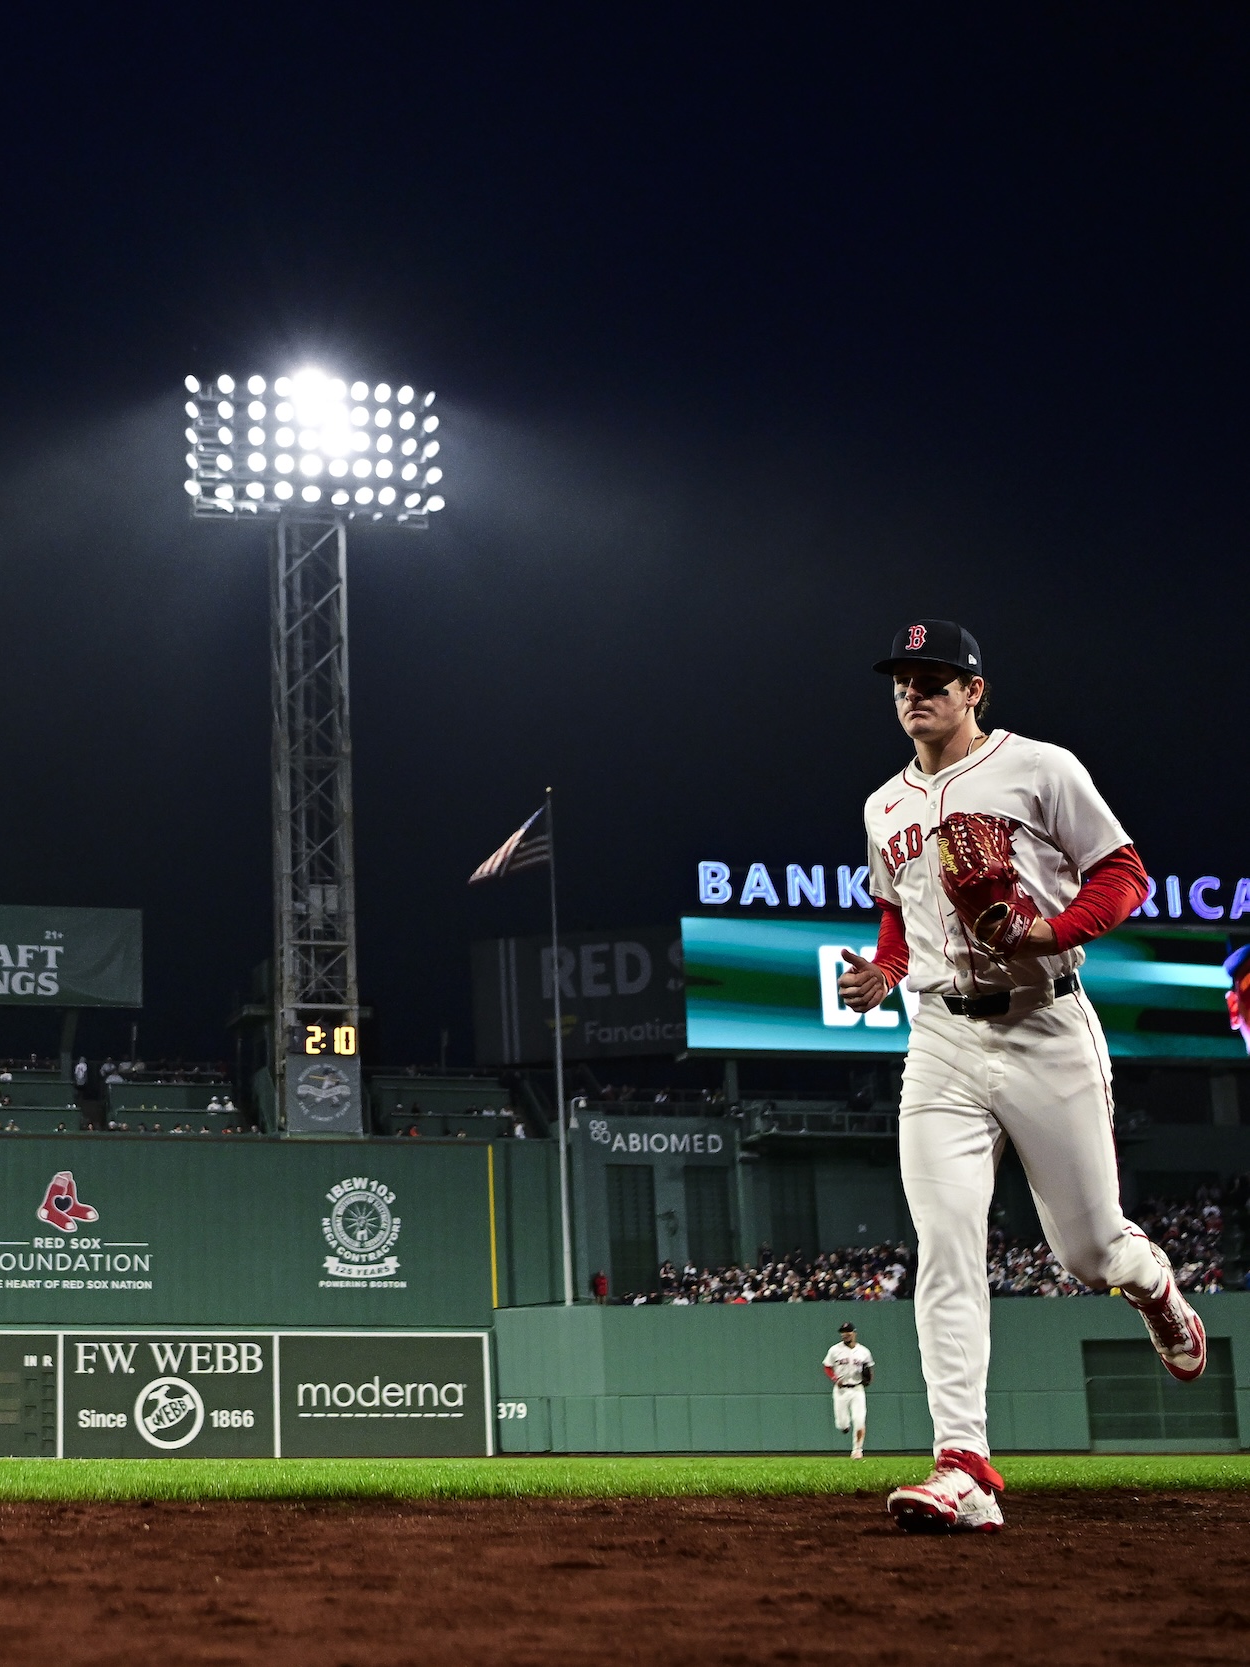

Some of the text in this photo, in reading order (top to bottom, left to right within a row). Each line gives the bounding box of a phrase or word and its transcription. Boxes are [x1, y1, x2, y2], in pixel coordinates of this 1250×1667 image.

[905, 624, 927, 650] B
[698, 860, 875, 909] BANK
[540, 940, 653, 1000] RED
[305, 1024, 357, 1056] 2:10
[610, 1132, 724, 1153] ABIOMED
[325, 1177, 397, 1205] IBEW 103
[33, 1237, 102, 1250] RED SOX
[5, 1280, 42, 1289] HEART
[44, 1280, 60, 1289] OF
[62, 1280, 85, 1289] RED
[86, 1280, 109, 1290] SOX
[111, 1280, 153, 1290] NATION
[23, 1354, 38, 1367] IN
[42, 1354, 53, 1367] R
[74, 1342, 264, 1375] F.W. WEBB
[297, 1375, 465, 1408] moderna
[78, 1409, 255, 1429] Since 1866
[152, 1399, 188, 1427] WEBB
[497, 1402, 528, 1419] 379
